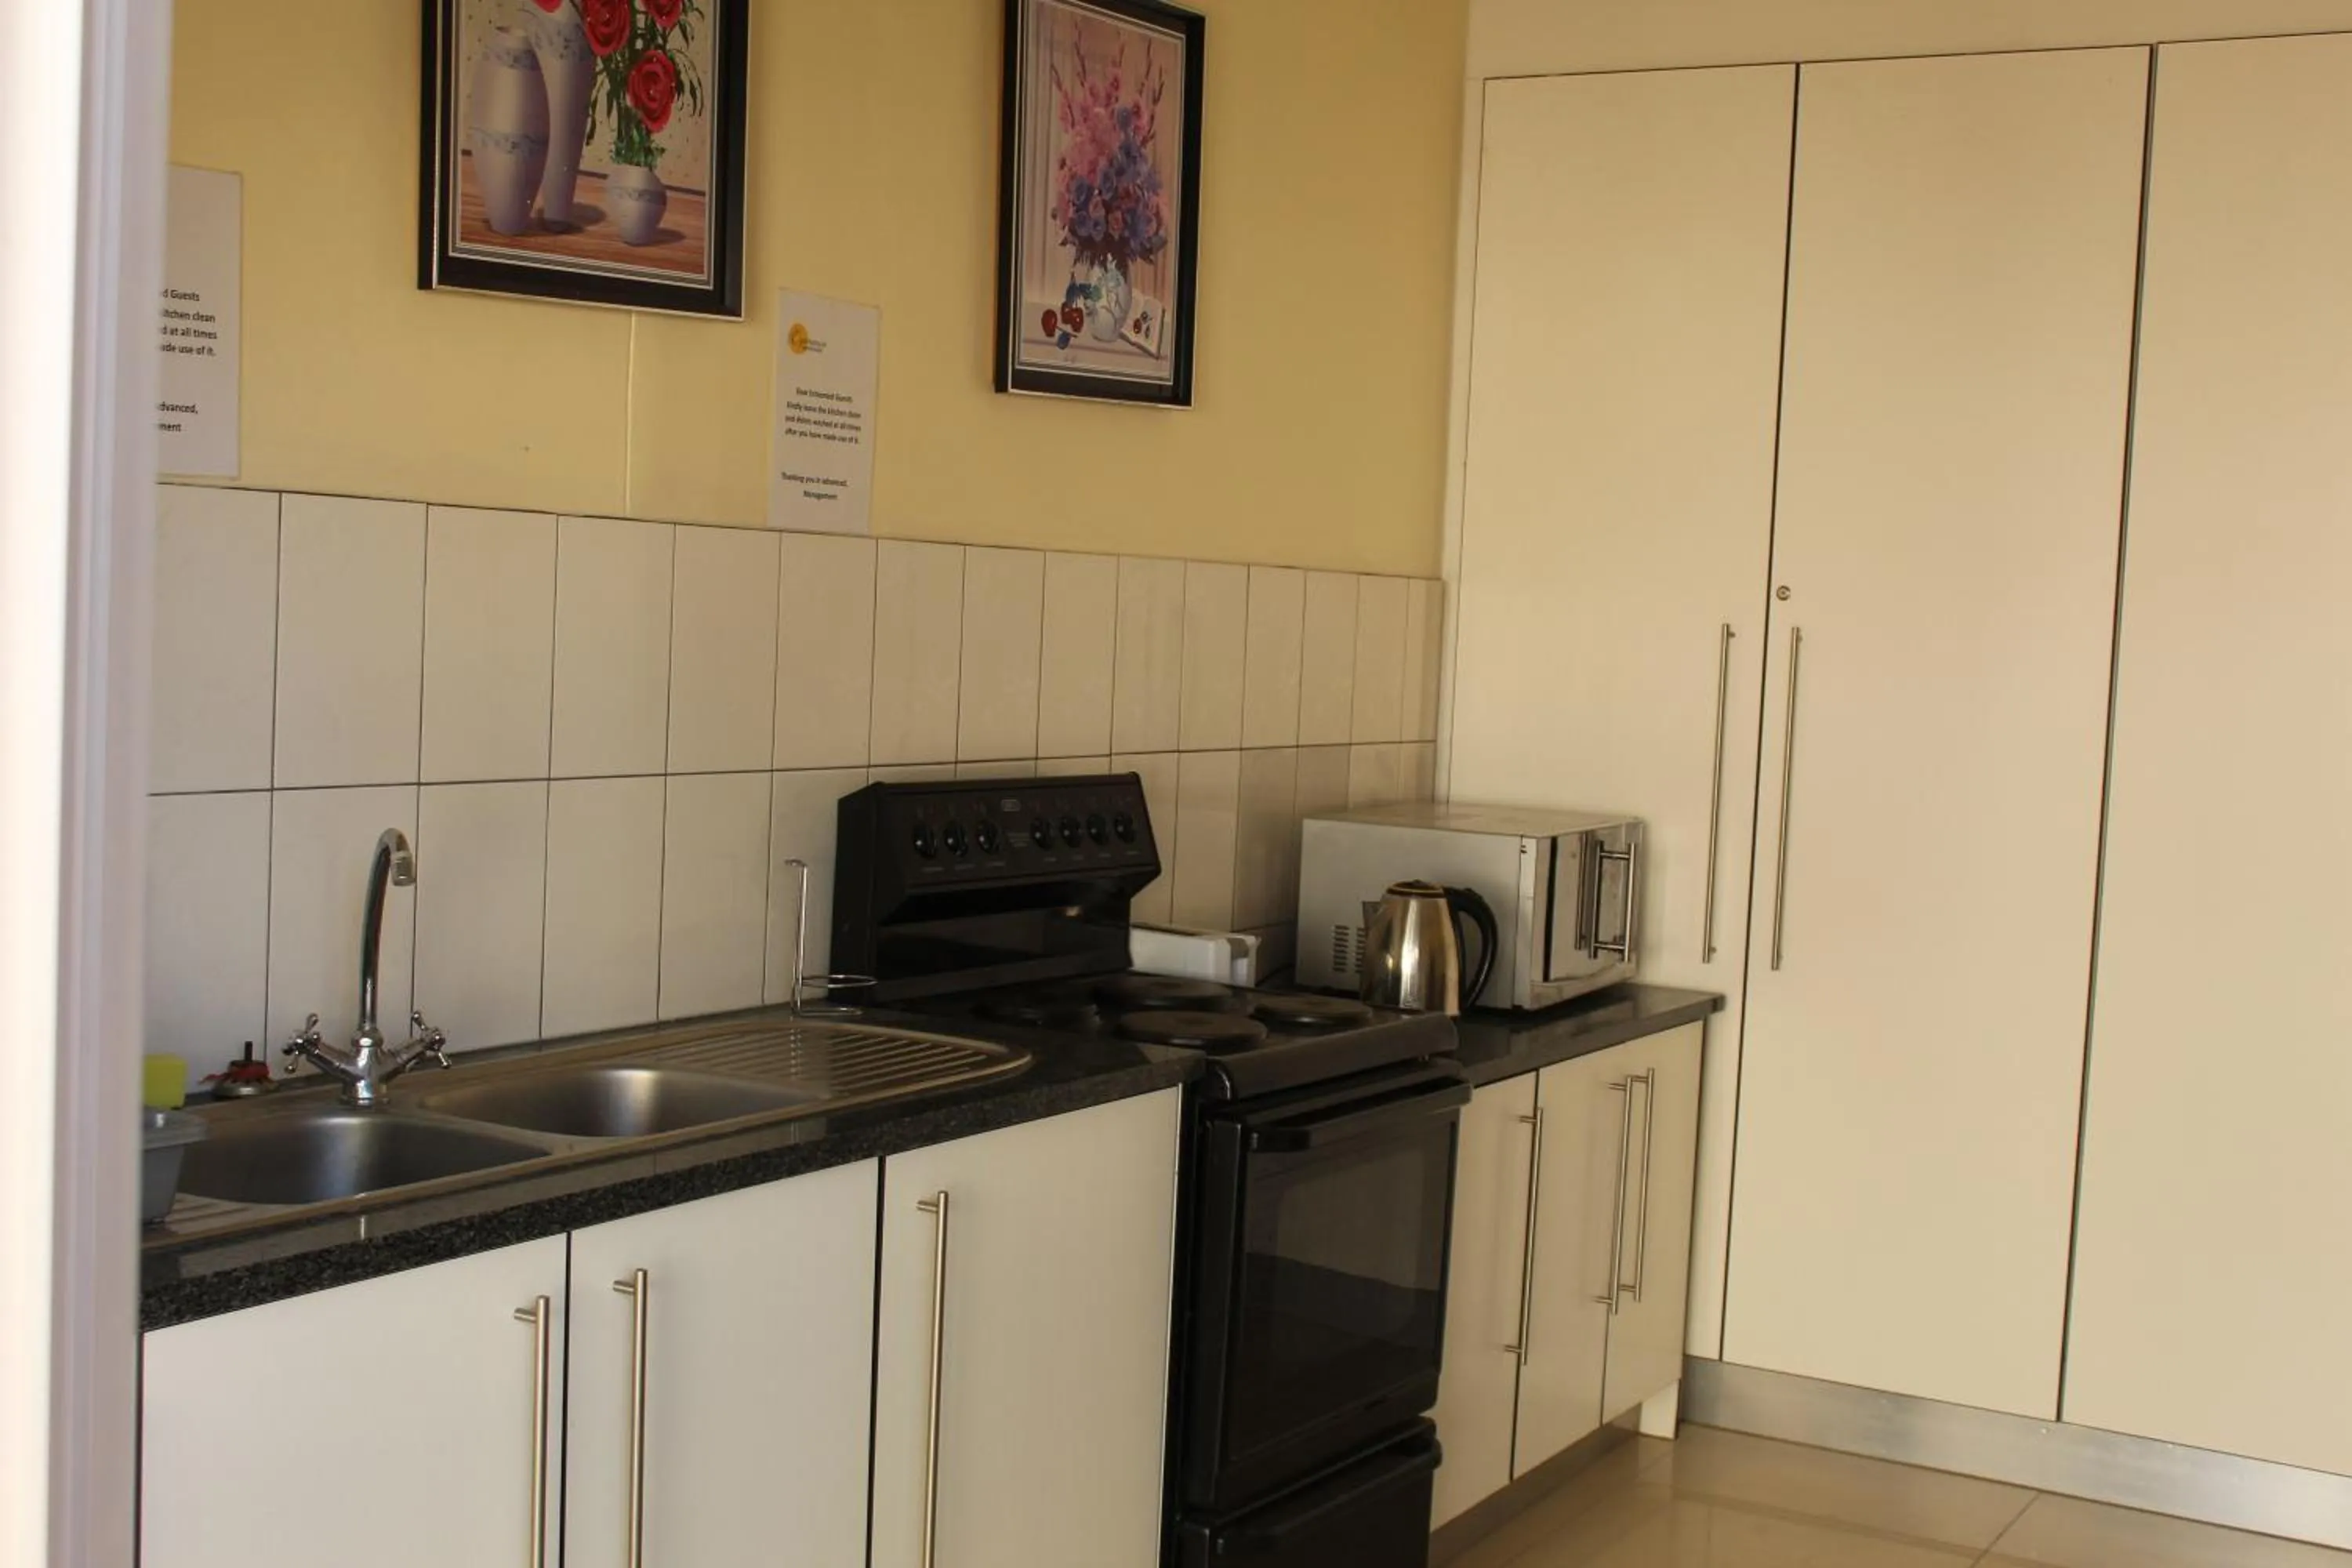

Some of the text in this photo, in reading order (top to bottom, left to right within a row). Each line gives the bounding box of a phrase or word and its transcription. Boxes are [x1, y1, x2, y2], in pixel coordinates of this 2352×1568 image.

[170, 289, 200, 301] Guests
[192, 310, 216, 323] clean
[169, 327, 179, 336] at
[180, 328, 191, 336] all
[193, 328, 217, 339] times
[179, 345, 194, 354] use
[196, 345, 205, 355] of
[158, 401, 198, 415] dvanced,
